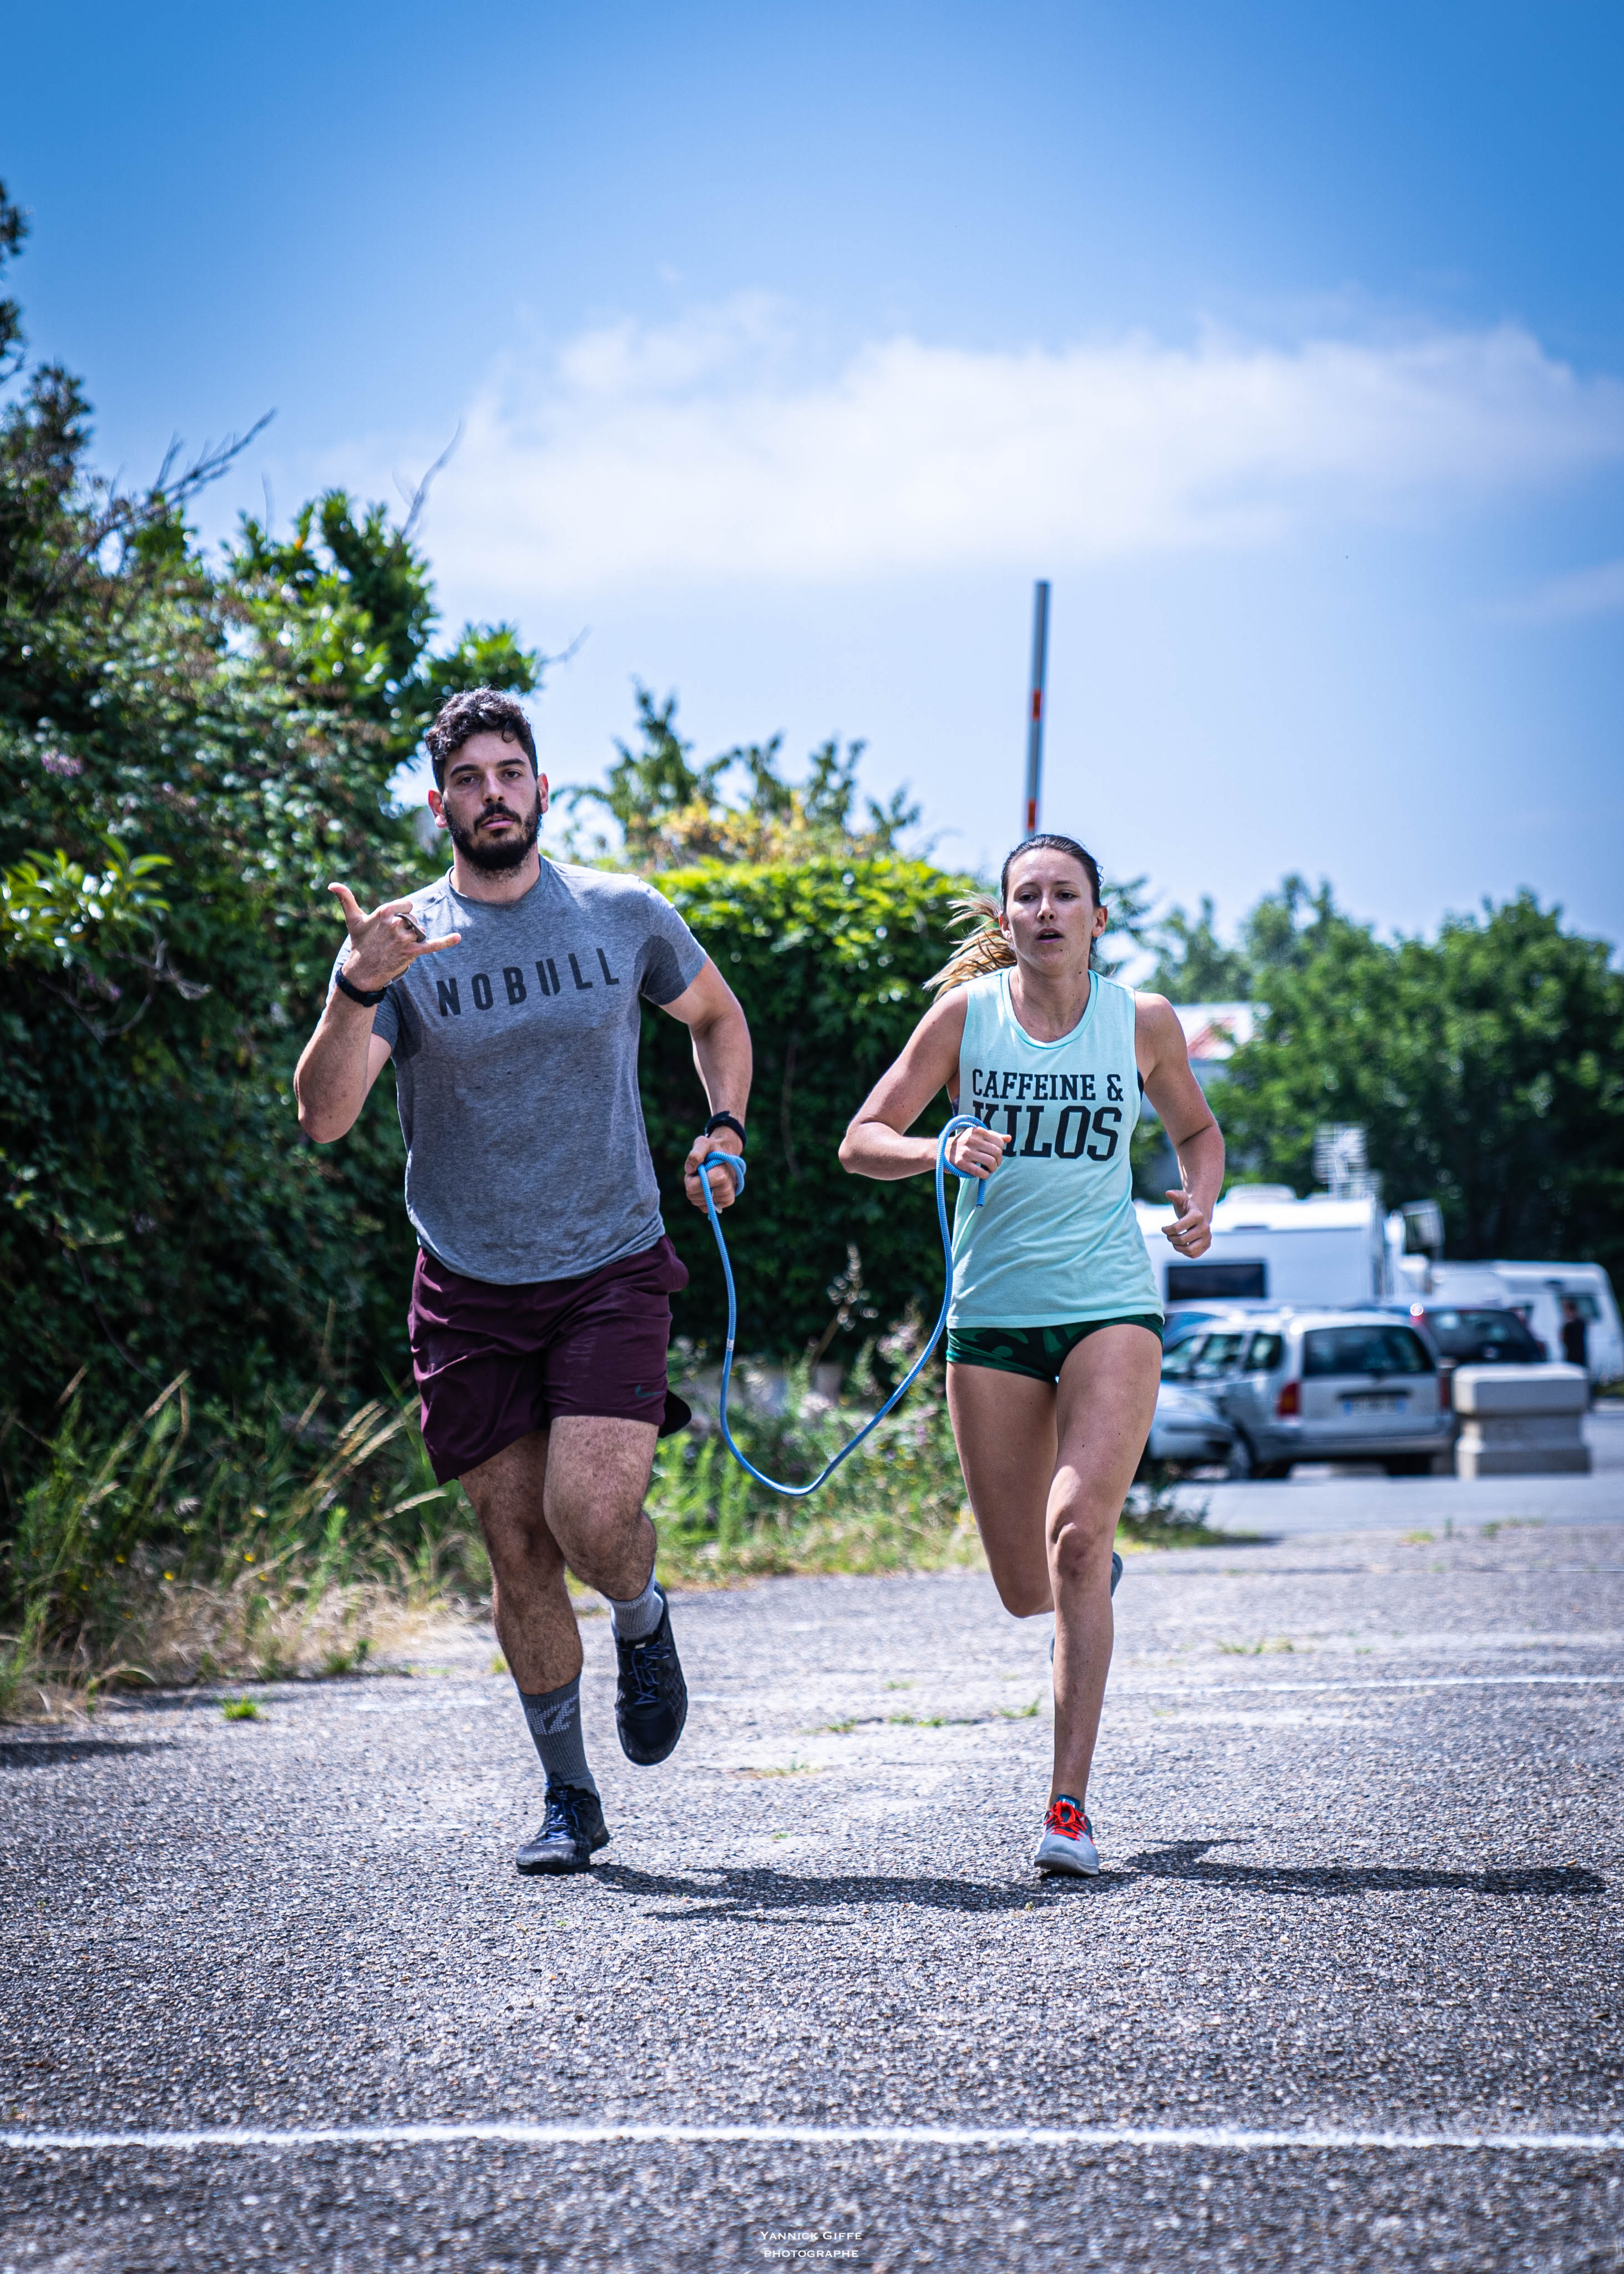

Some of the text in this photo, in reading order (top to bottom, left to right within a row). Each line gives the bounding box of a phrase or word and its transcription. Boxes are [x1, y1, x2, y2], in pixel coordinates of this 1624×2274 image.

[436, 948, 620, 1017] NOBULL
[972, 1069, 1124, 1101] CAFFEINE &
